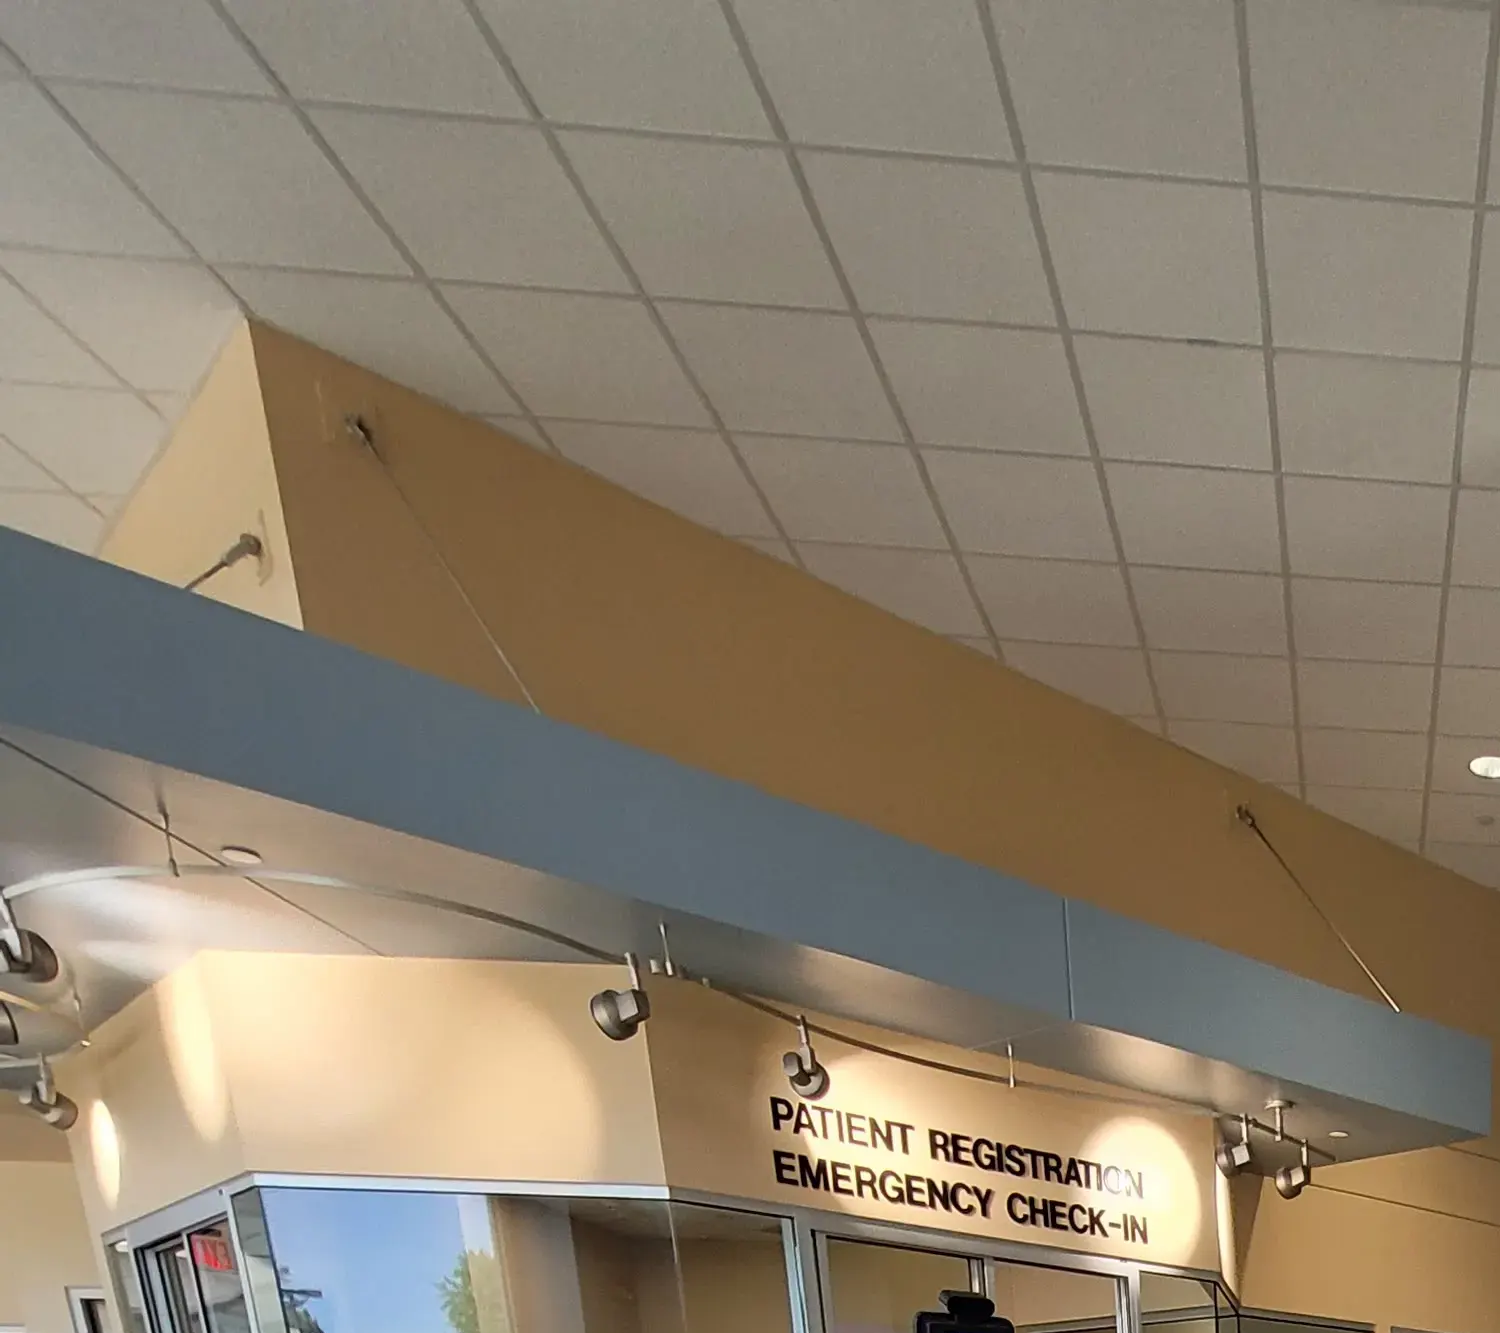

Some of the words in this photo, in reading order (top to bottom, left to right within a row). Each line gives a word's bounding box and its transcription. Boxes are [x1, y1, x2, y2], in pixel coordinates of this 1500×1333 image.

[771, 1097, 915, 1154] PATIENT
[930, 1128, 1144, 1199] REGISTRATION
[774, 1150, 993, 1217] EMERGENCY
[1007, 1192, 1148, 1244] CHECK-IN
